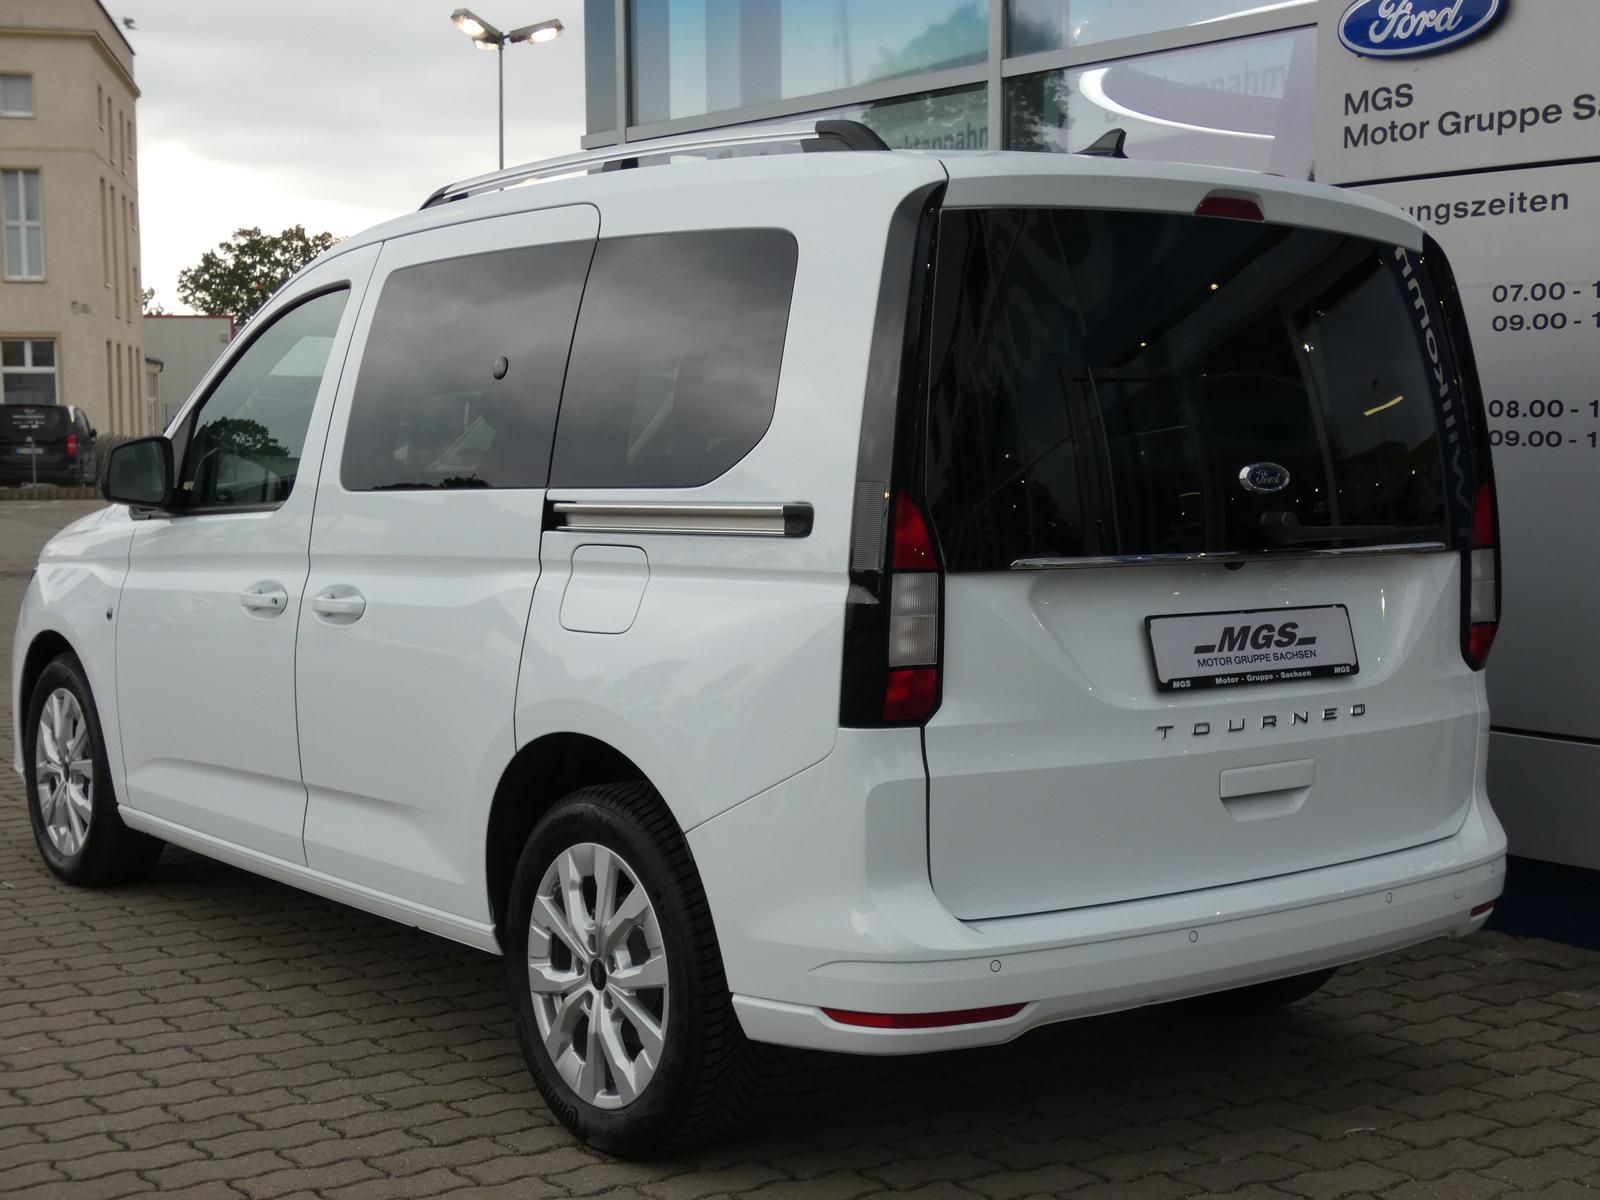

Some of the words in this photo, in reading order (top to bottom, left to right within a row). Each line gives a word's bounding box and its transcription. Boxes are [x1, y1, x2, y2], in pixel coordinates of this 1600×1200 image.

[1369, 0, 1464, 43] Ford
[1344, 83, 1414, 116] MGS
[1343, 119, 1430, 149] Motor
[1437, 102, 1563, 136] Gruppe
[1573, 94, 1600, 121] S
[1492, 282, 1566, 303] 07.00
[1492, 312, 1567, 332] 09.00
[1488, 399, 1564, 418] 08.00
[1489, 430, 1563, 448] 09.00
[1197, 655, 1233, 668] MOTOR
[1234, 652, 1272, 665] GRUPPE
[1273, 649, 1317, 663] SACHSEN
[1172, 680, 1192, 689] MGS
[1215, 677, 1239, 685] Motor
[1247, 674, 1274, 683] Gruppe
[1281, 670, 1312, 679] Sachsen
[1334, 665, 1351, 674] MGS
[1156, 703, 1366, 740] TOURNEO
